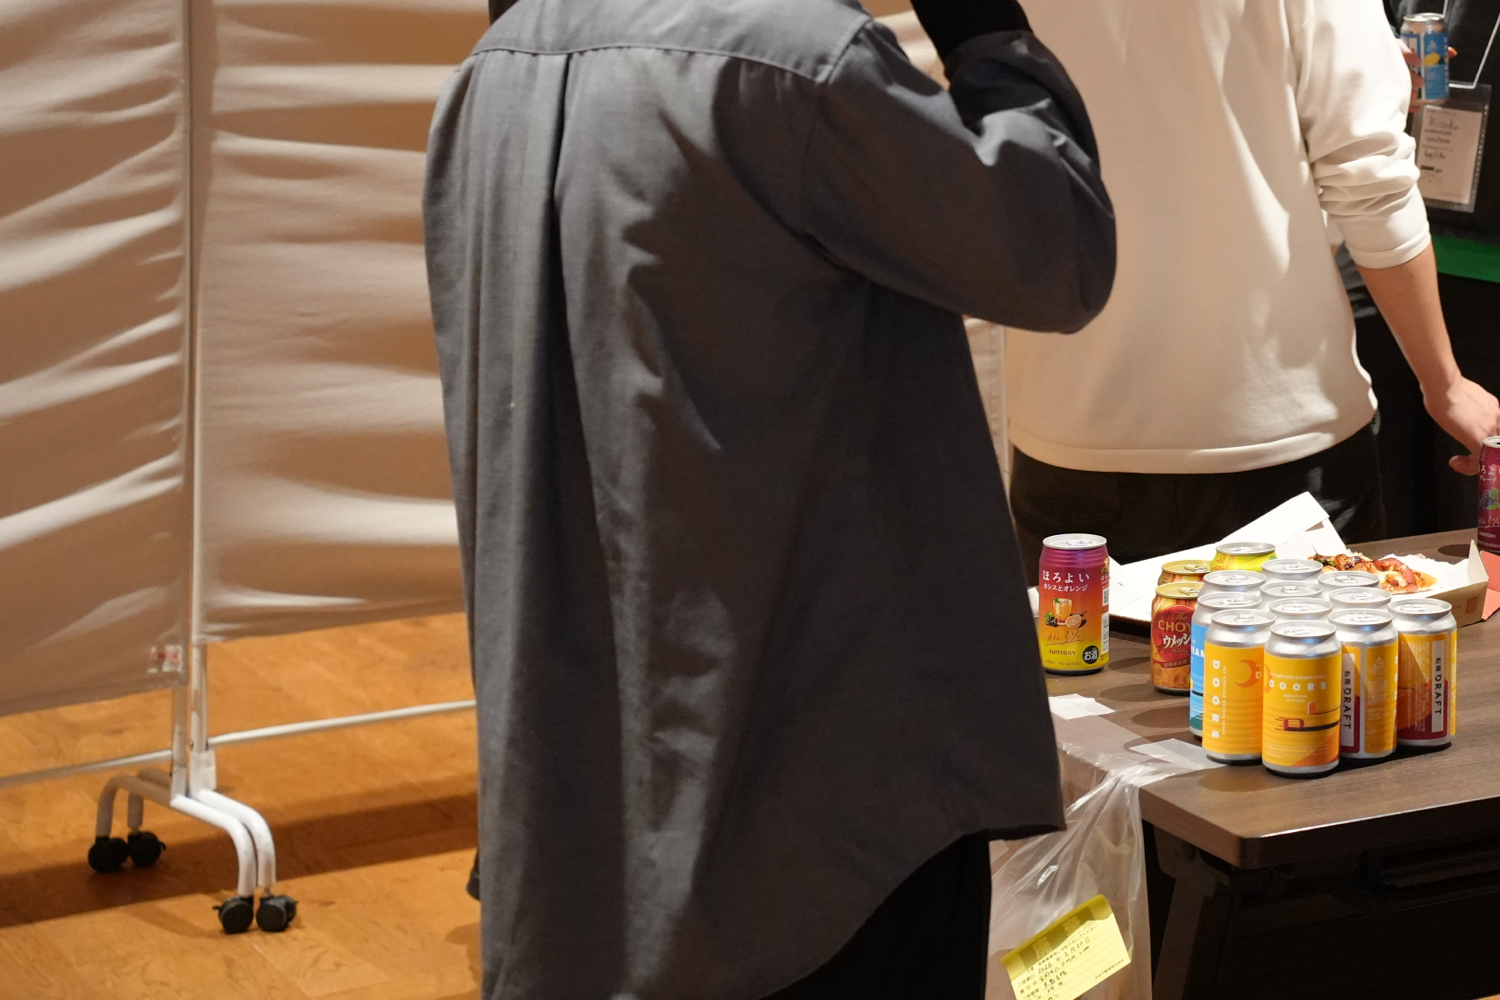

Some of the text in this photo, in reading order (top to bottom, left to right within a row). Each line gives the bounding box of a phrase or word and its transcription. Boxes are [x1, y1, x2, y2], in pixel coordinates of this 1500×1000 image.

[1042, 570, 1090, 584] ほろよい
[1043, 583, 1088, 592] カシスとオレンジ
[1084, 649, 1098, 661] お酒
[1269, 679, 1326, 692] DOORS
[1211, 659, 1221, 739] DOORS
